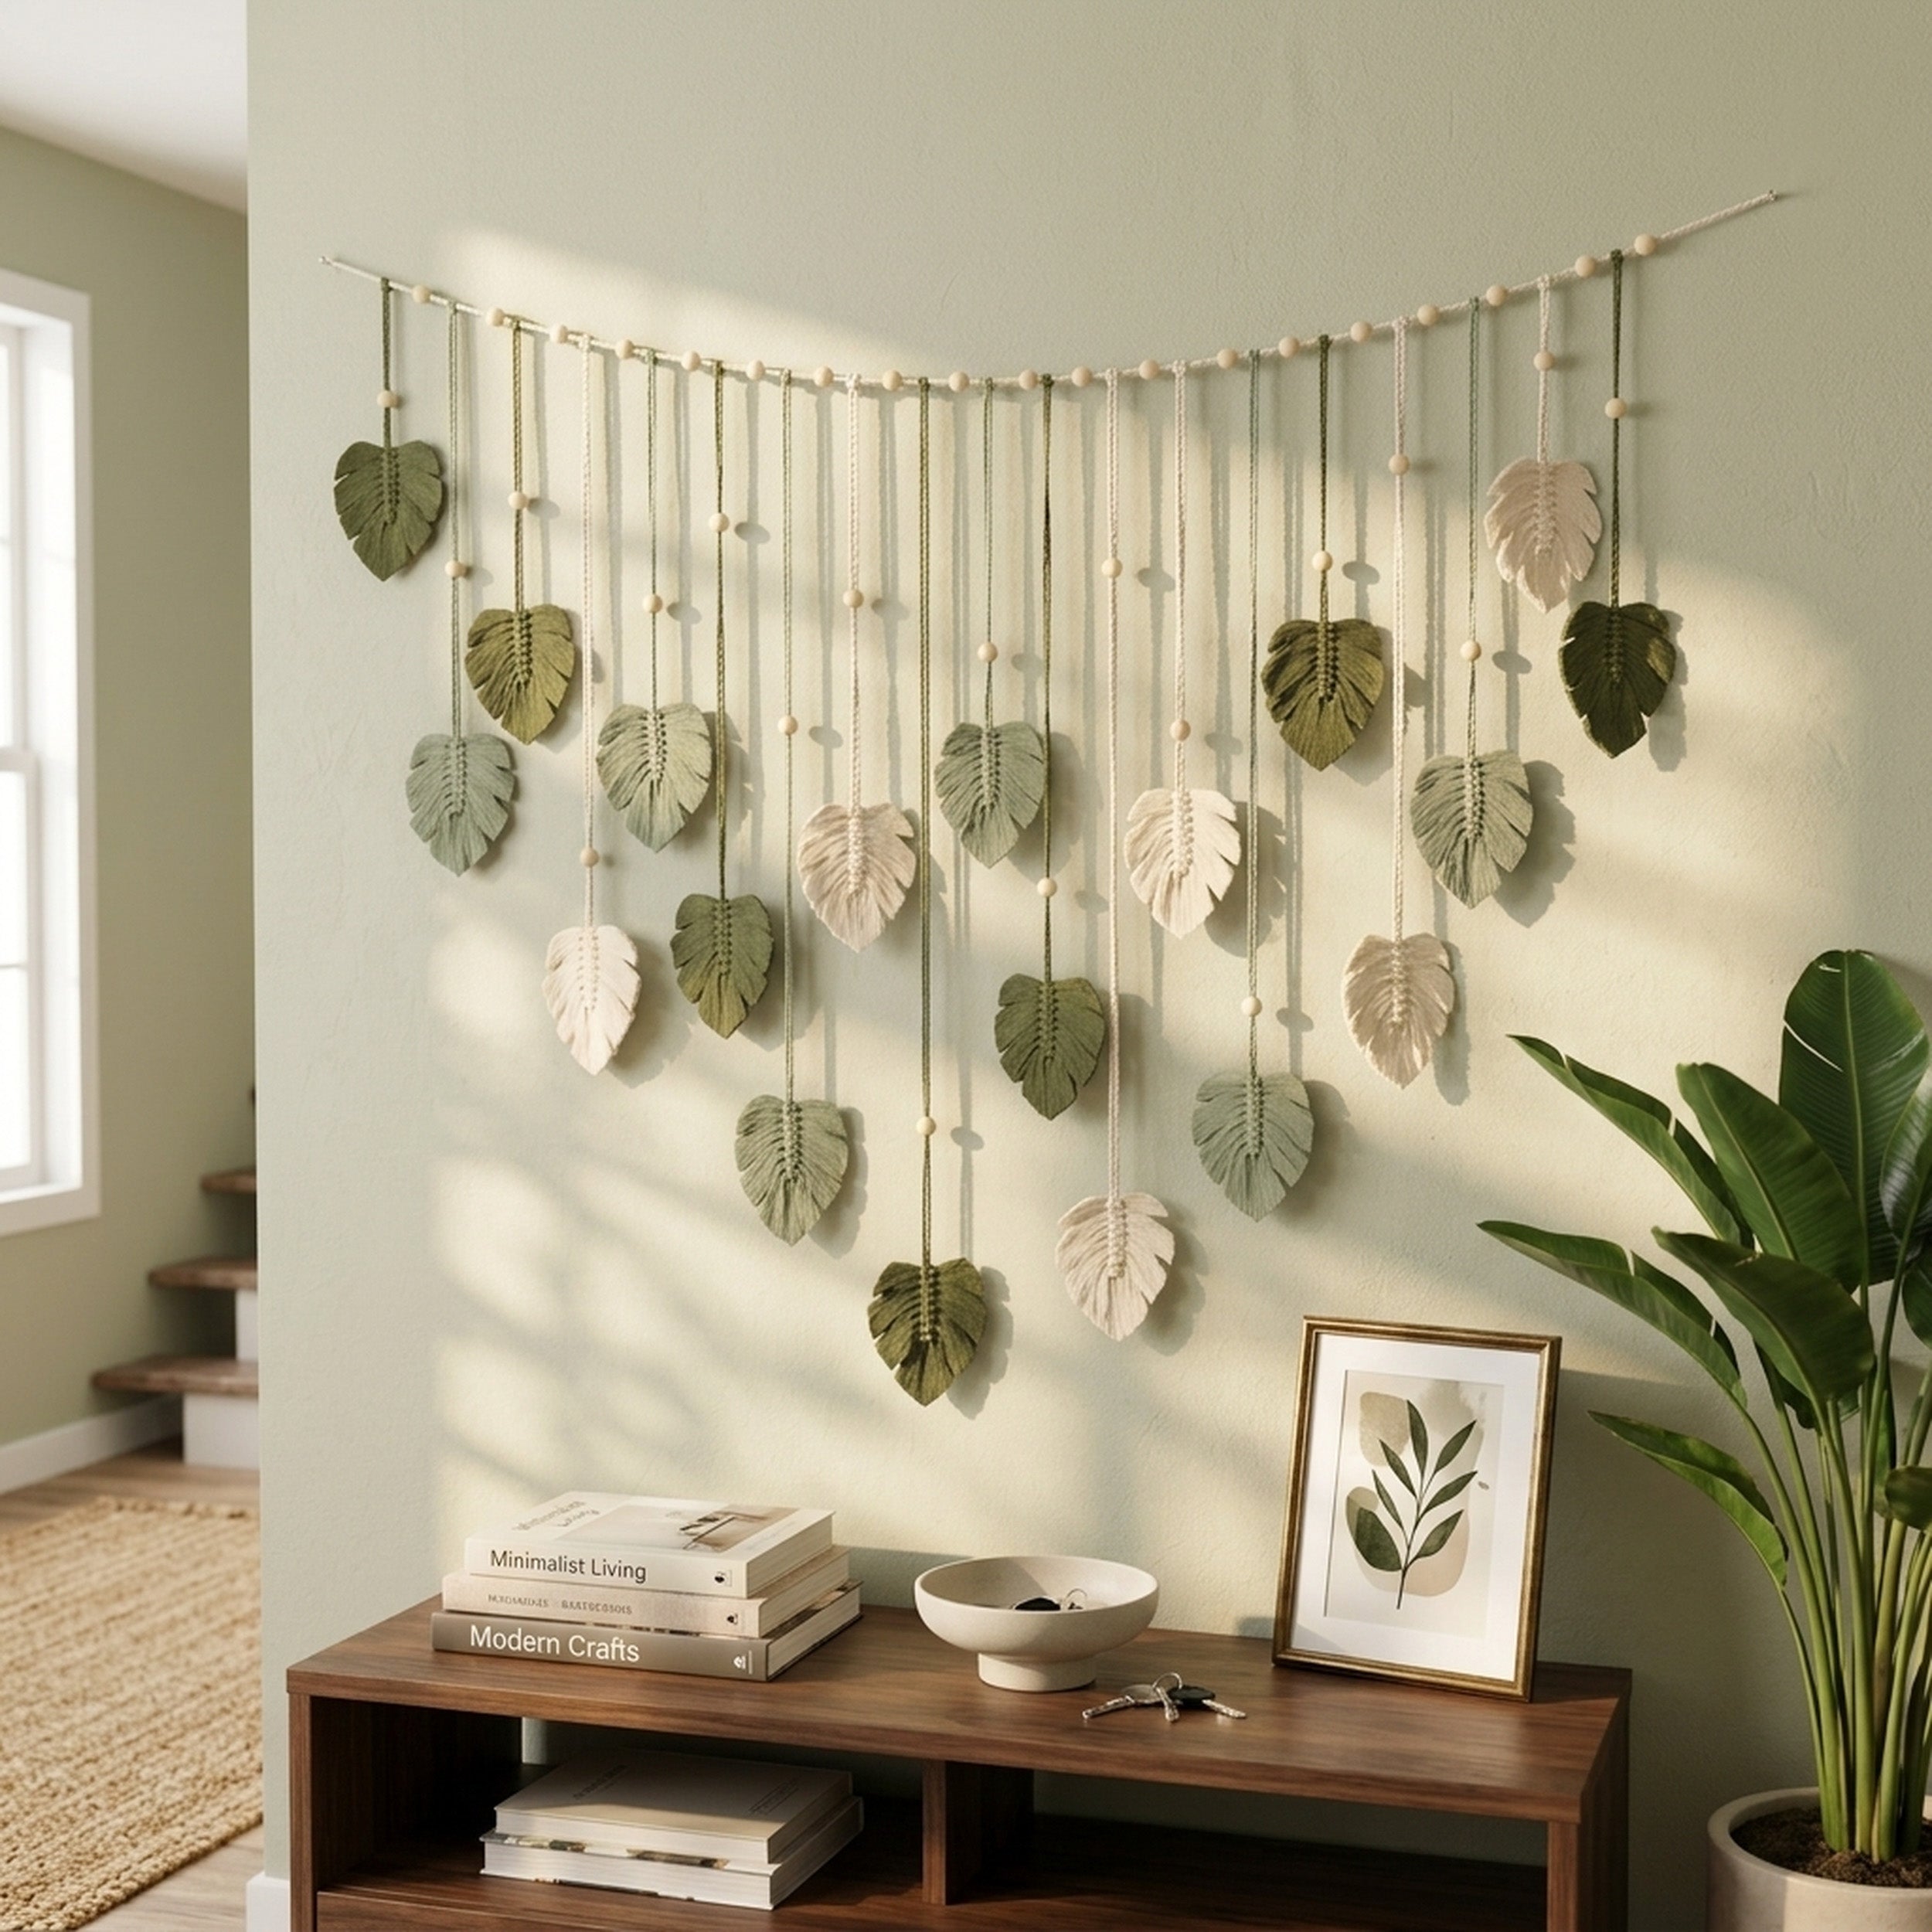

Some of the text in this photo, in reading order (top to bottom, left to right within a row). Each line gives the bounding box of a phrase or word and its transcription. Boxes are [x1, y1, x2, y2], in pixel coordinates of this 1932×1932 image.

[490, 1549, 646, 1583] Minimalist Living
[470, 1624, 640, 1662] Modern Crafts
